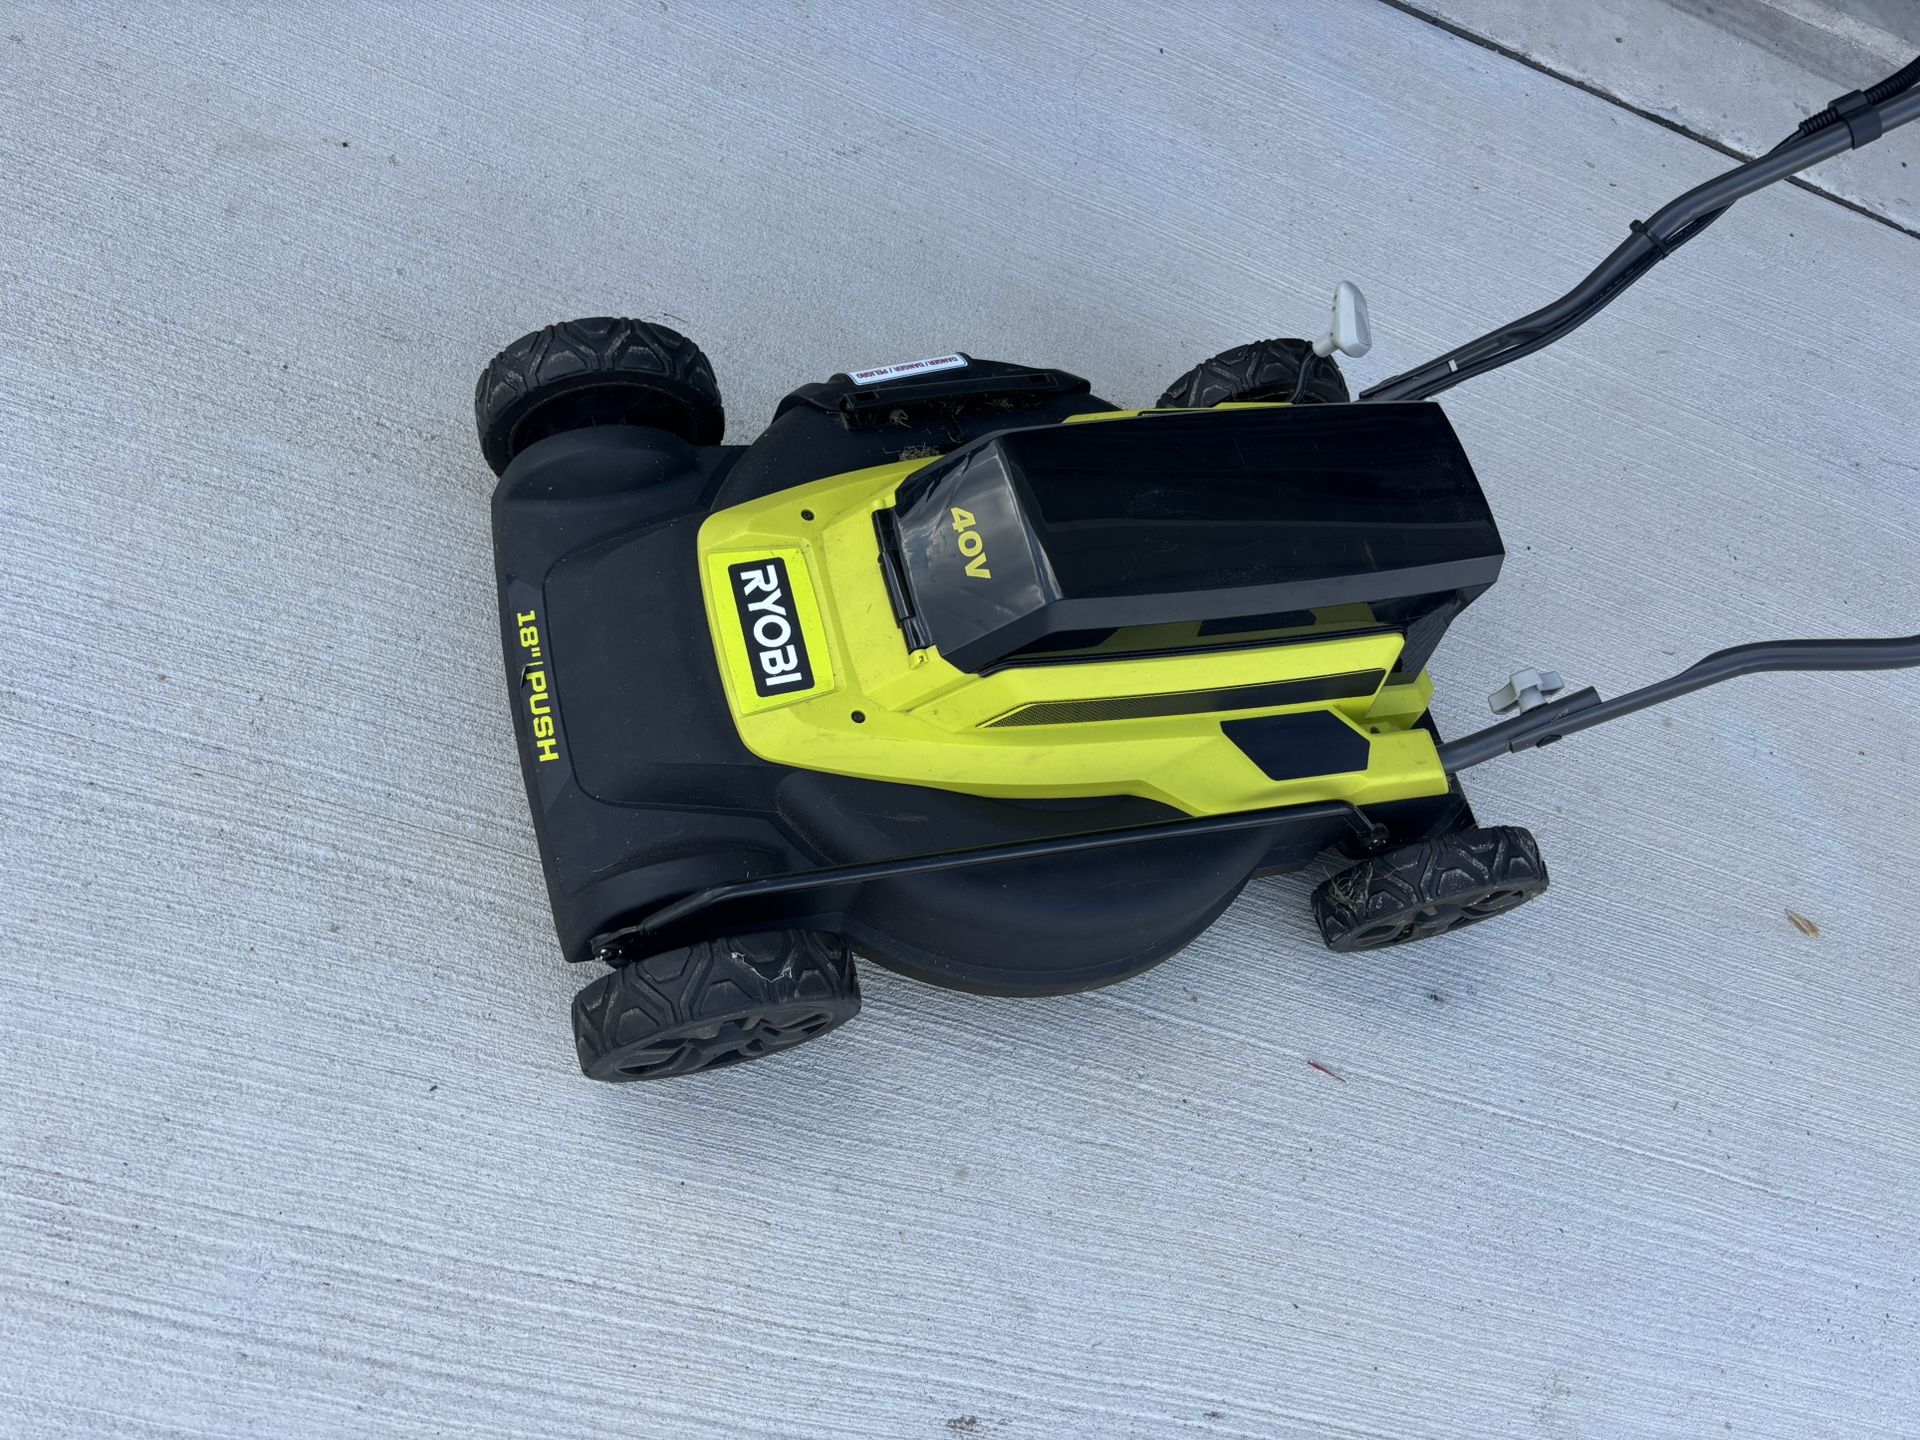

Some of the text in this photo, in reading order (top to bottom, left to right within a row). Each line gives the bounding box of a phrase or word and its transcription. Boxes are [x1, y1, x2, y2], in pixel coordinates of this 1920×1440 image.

[857, 369, 888, 378] PELIGRO
[895, 362, 924, 371] DANGER
[928, 356, 958, 366] DANGER
[950, 507, 992, 579] 40V
[740, 564, 803, 686] RYOBI
[516, 610, 559, 762] 18" PUSH
